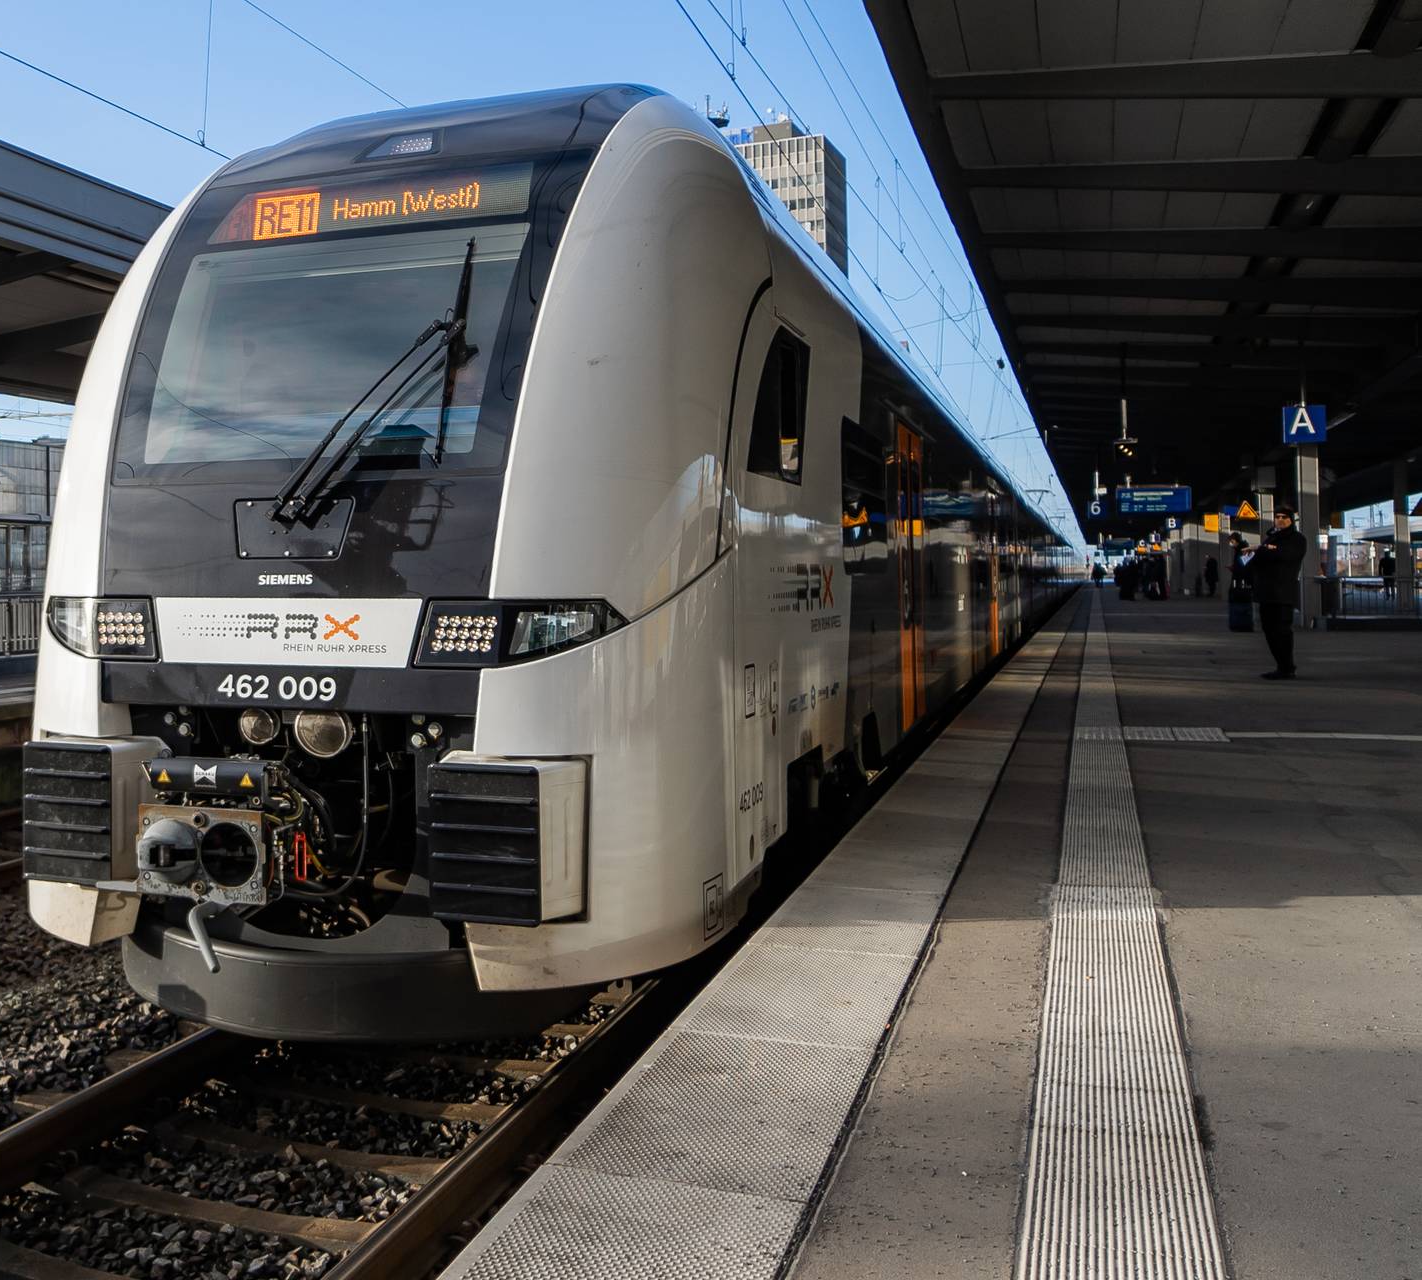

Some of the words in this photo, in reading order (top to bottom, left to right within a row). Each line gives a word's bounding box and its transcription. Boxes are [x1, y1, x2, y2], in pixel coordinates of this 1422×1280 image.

[259, 199, 316, 237] RE11
[333, 198, 396, 220] Hamm
[1290, 407, 1316, 435] A
[1090, 501, 1101, 515] 6
[1168, 518, 1176, 528] B
[258, 574, 313, 586] SIEMENS
[246, 613, 361, 641] RRX
[283, 643, 314, 652] RHEIN
[317, 643, 345, 653] RUHR
[348, 644, 387, 654] XPRESS
[217, 673, 270, 700] 462
[278, 675, 337, 701] 009
[739, 788, 751, 814] 462
[752, 781, 763, 807] 009
